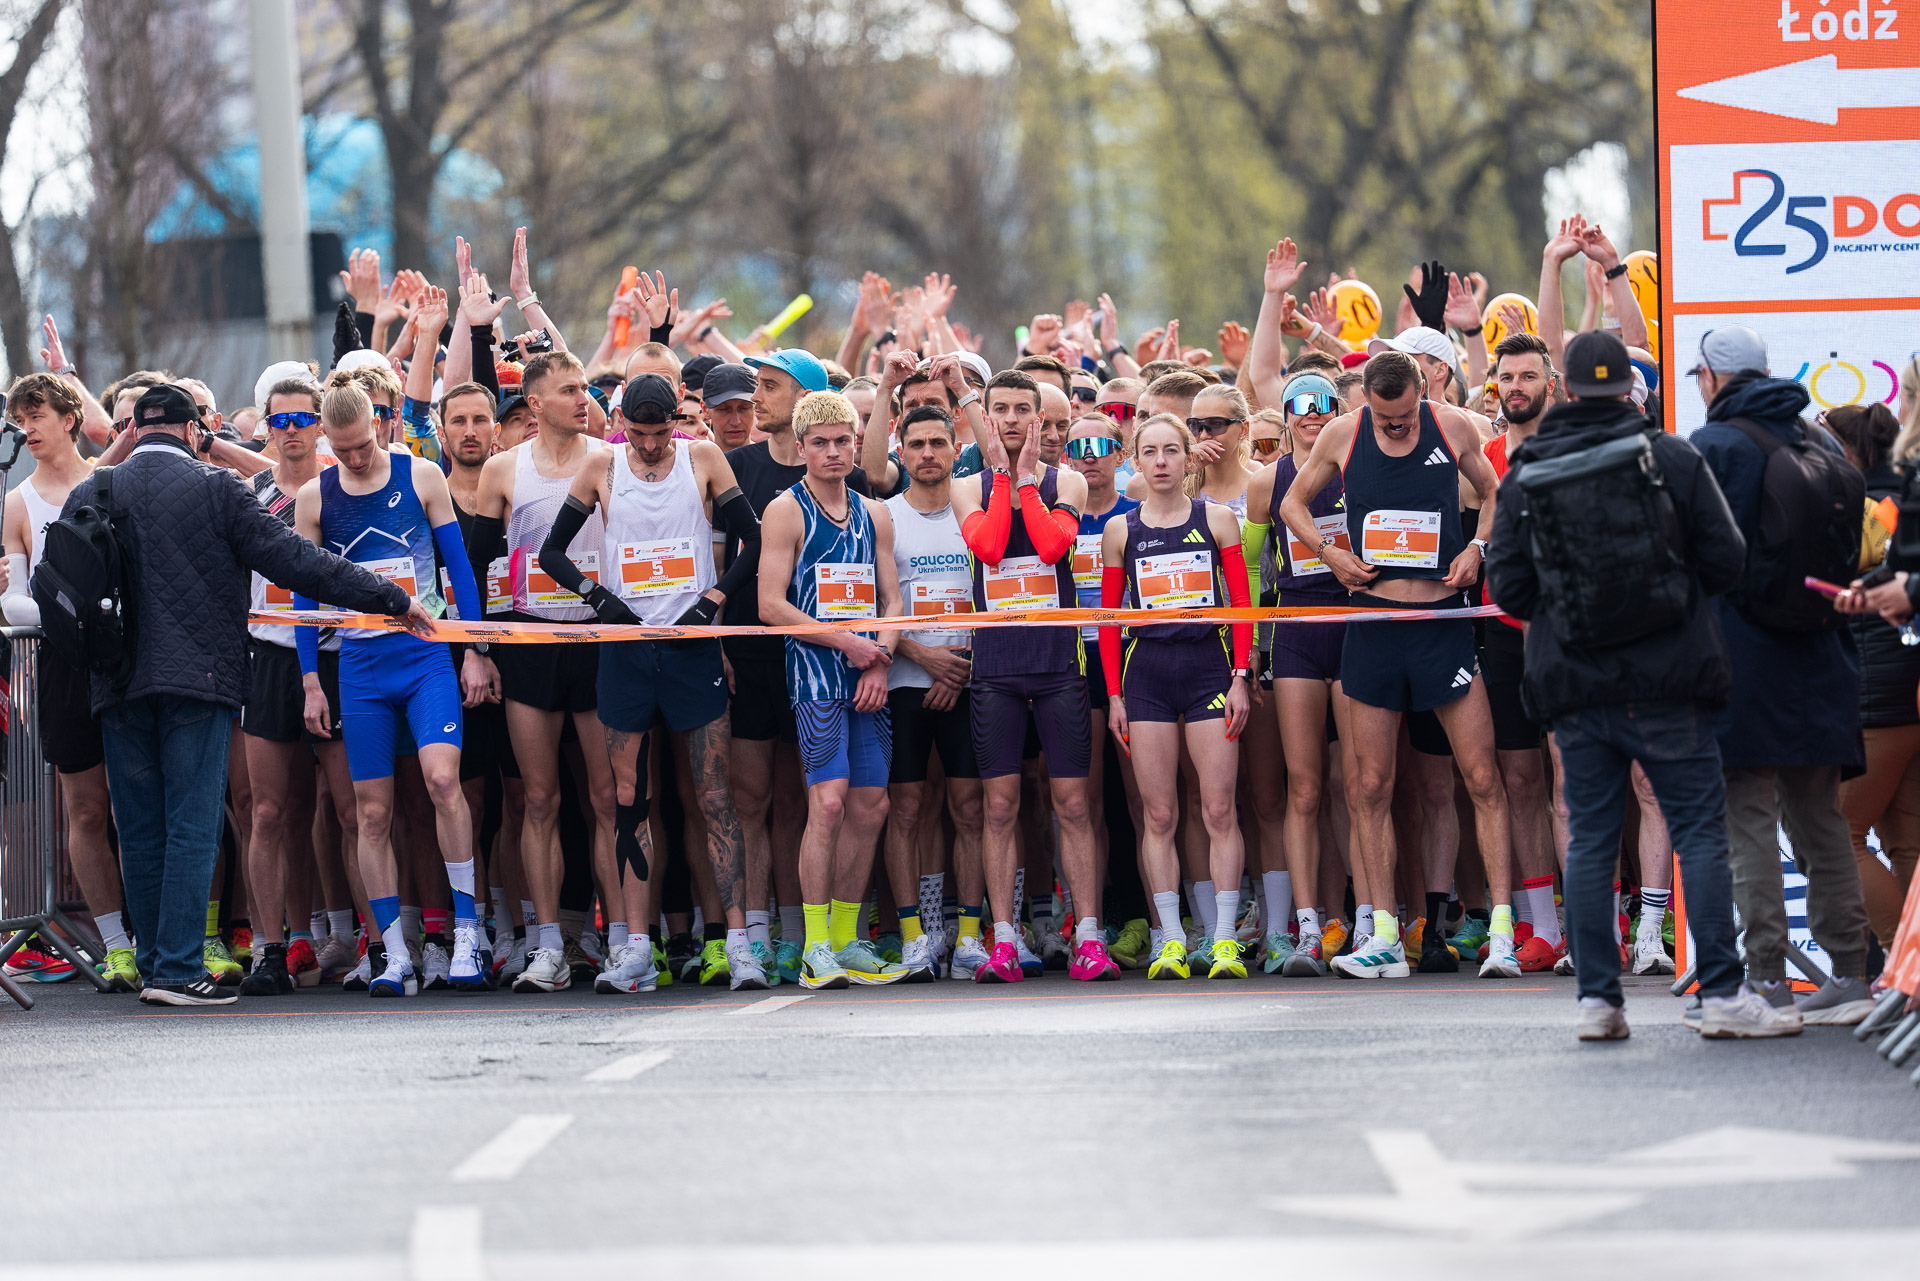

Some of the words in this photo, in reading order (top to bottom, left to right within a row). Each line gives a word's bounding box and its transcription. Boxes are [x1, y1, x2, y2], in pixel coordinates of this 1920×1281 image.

[1833, 244, 1878, 252] PACJENT
[1880, 243, 1892, 252] W
[1395, 531, 1409, 547] 4
[651, 560, 664, 576] 5
[909, 554, 970, 568] saucony
[918, 566, 945, 574] Ukraine
[1017, 577, 1026, 592] 1
[1168, 573, 1184, 588] 11
[845, 583, 855, 598] 8
